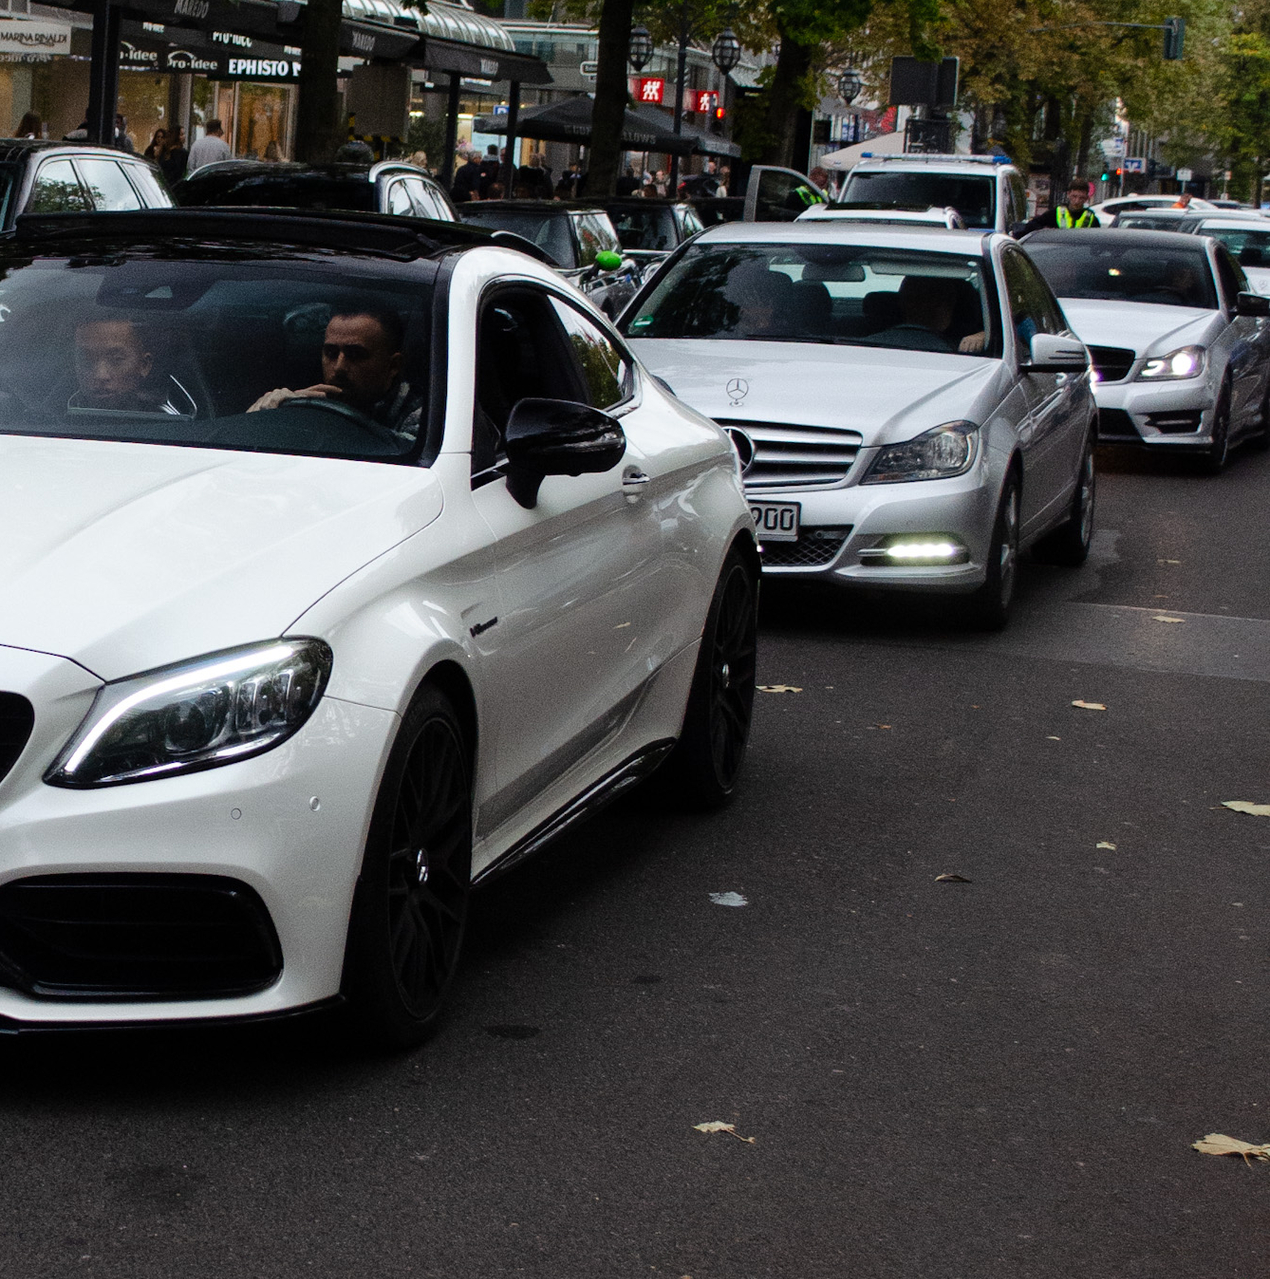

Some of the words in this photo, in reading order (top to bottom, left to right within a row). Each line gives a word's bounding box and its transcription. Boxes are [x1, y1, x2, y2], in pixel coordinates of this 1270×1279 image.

[0, 31, 33, 43] MARINA
[34, 33, 68, 44] RINALDI
[228, 58, 289, 77] EPHISTO
